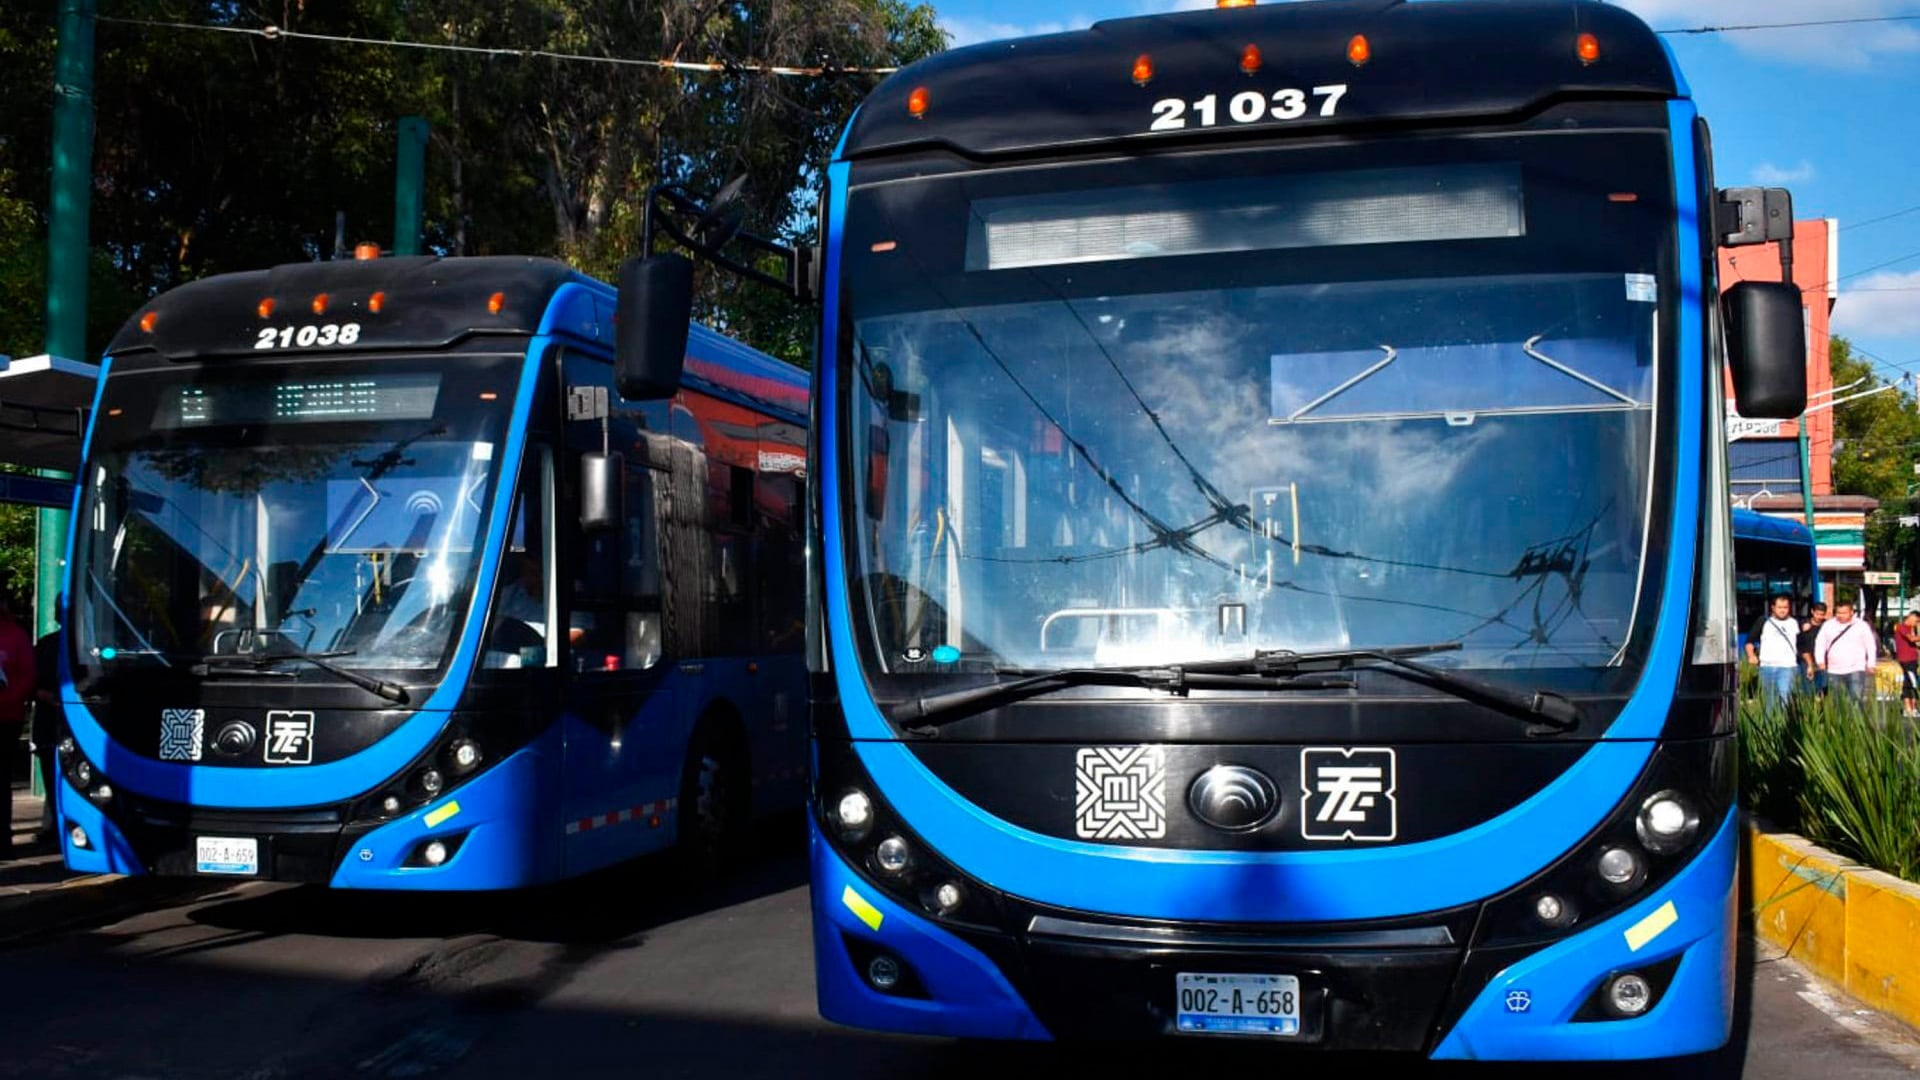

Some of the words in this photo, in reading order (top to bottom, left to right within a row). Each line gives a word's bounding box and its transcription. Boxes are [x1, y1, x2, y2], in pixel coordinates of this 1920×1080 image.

[1150, 84, 1347, 131] 21037
[254, 323, 360, 349] 21038
[1181, 988, 1294, 1015] 002-A-658
